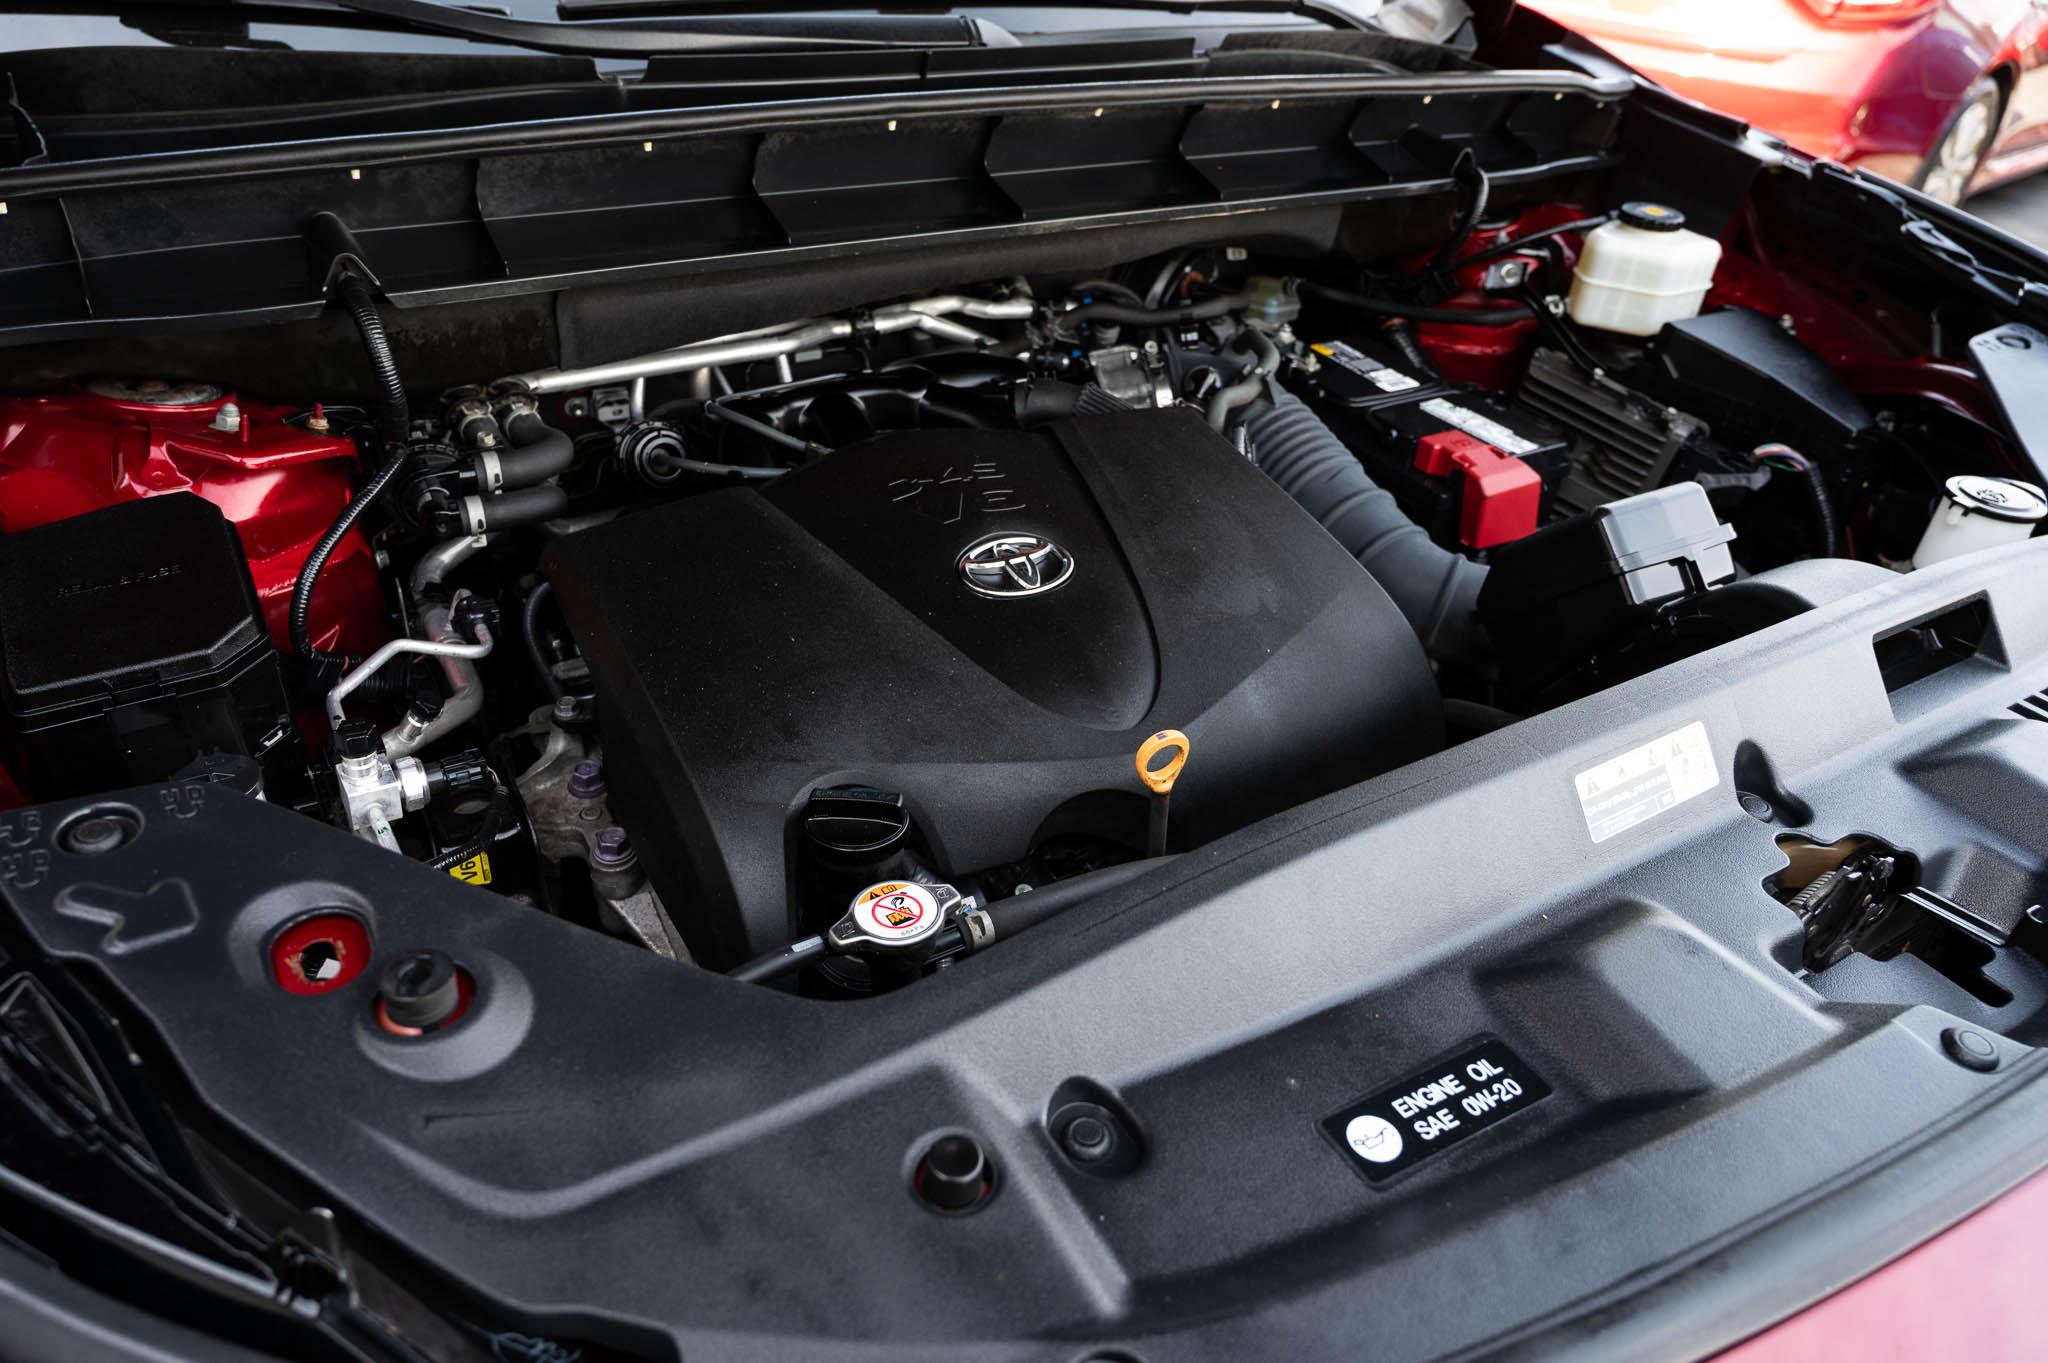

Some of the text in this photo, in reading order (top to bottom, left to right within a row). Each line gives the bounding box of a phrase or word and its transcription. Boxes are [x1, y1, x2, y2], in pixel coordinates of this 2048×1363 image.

[1391, 1058, 1504, 1119] ENGINE OIL
[1413, 1078, 1523, 1140] SAE 0W-20
